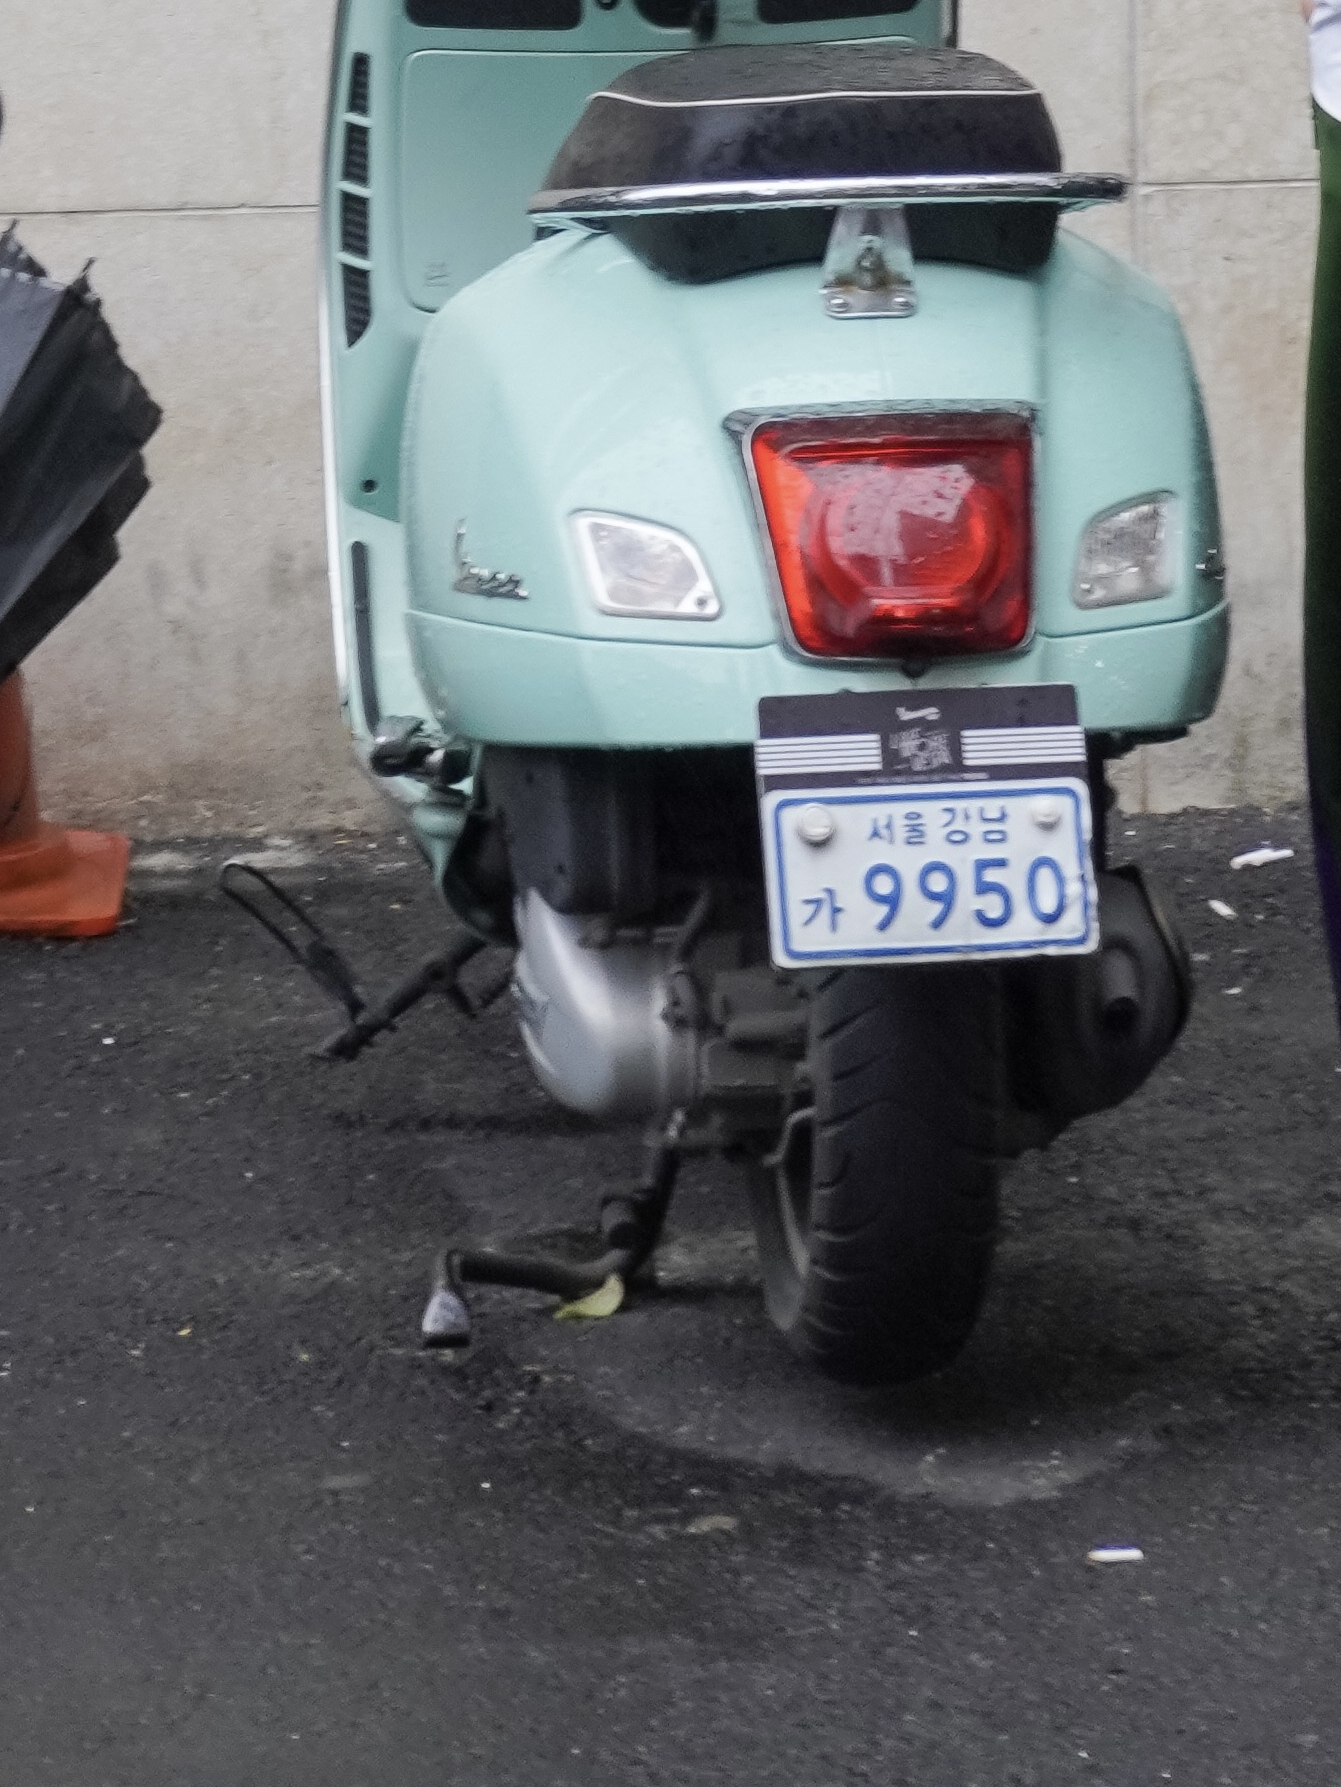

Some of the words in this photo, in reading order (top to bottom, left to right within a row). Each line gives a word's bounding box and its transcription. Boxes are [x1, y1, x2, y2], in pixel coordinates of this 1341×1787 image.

[867, 811, 927, 846] 서울
[942, 805, 1009, 846] 강남
[864, 855, 1066, 932] 9950
